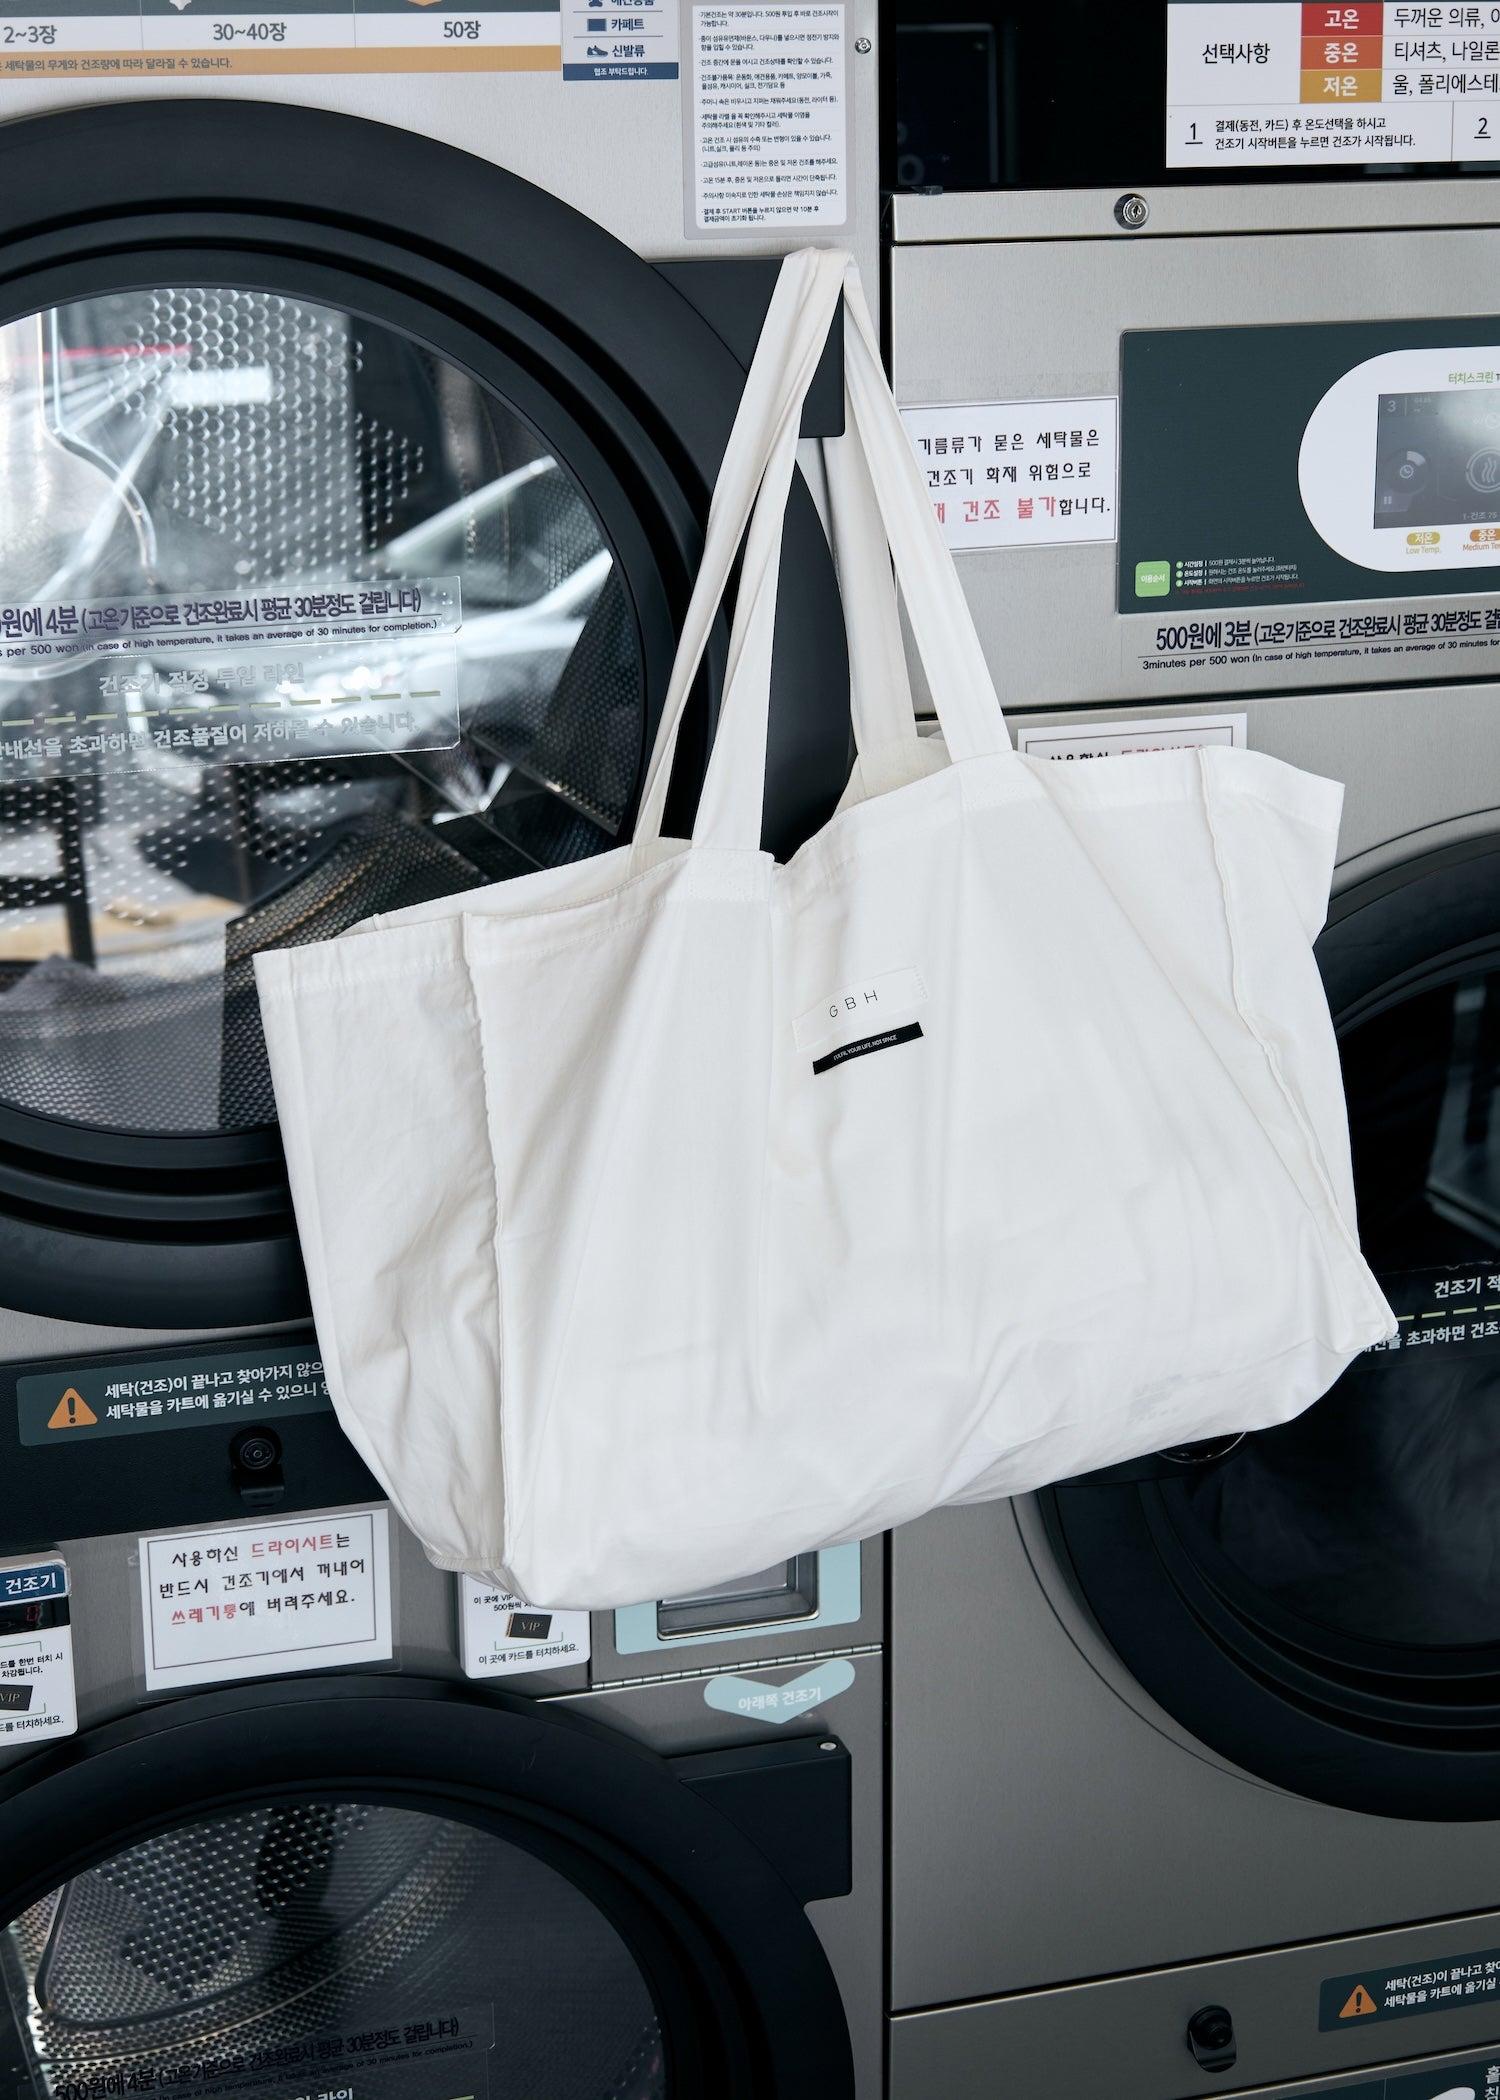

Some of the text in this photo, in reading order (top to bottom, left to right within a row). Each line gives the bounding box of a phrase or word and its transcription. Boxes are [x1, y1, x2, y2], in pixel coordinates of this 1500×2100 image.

[611, 19, 644, 31] 카페트
[1324, 8, 1360, 30] 고온
[1393, 7, 1443, 29] 두꺼운
[1449, 7, 1485, 29] 의류,
[3, 25, 57, 44] 2~3장
[213, 22, 287, 42] 30~40장
[443, 20, 481, 40] 50장
[612, 45, 645, 58] 신발류
[1202, 42, 1270, 65] 선택사항
[1323, 42, 1359, 63] 중온
[1394, 40, 1500, 62] 티셔츠, 나일론
[5, 61, 45, 72] 세탁물의
[48, 60, 77, 70] 무게와
[123, 59, 143, 69] 따라
[191, 57, 233, 68] 있습니다.
[1323, 74, 1358, 97] 저온
[1393, 74, 1414, 96] 울,
[1215, 118, 1386, 133] 결제(동전, 카드) 후 온도선택을 하시고
[1478, 118, 1488, 134] 2
[1215, 134, 1416, 150] 건조기 시작버튼을 누르면 건조가 시작됩니다.
[1448, 371, 1493, 384] 터치스크린
[1387, 400, 1396, 412] 3
[918, 429, 1099, 455] 기름류가 묻은 세탁물은
[927, 461, 1091, 487] 건조기 화재 위험으로
[963, 499, 1000, 522] 건조
[1018, 496, 1110, 519] 불가합니다.
[46, 587, 421, 634] 4분 (고온기준으로 건조완료시 평균 30분정도 걸립니다)
[7, 648, 26, 657] per
[31, 645, 52, 654] 500
[56, 645, 79, 653] won
[134, 640, 154, 649] high
[157, 636, 214, 646] temperature,
[226, 633, 249, 642] takes
[253, 632, 264, 640] an
[267, 630, 303, 640] average
[318, 628, 329, 636] 30
[332, 626, 366, 635] minutes
[369, 625, 381, 633] for
[384, 620, 437, 632] completion.)
[1156, 610, 1482, 650] 500원에 3분 (고온기준으로 건조완료시 평균 30분정도
[1143, 661, 1186, 670] 3minutes
[1189, 659, 1206, 668] per
[1210, 656, 1227, 665] 500
[1231, 656, 1249, 664] won
[1264, 653, 1283, 661] case
[1285, 652, 1293, 660] of
[1296, 651, 1311, 660] high
[1315, 650, 1361, 658] temperature,
[1371, 646, 1391, 654] takes
[1406, 644, 1435, 653] average
[1448, 641, 1457, 649] 30
[1459, 640, 1488, 648] minutes
[99, 670, 209, 697] 건조기 적정
[69, 723, 247, 754] 초과하면 건조품질이
[829, 990, 878, 1017] GBH
[1434, 1276, 1482, 1298] 건조기
[1406, 1324, 1466, 1345] 초과하면
[105, 1364, 293, 1399] 세탁(건조)이 끝나고 찾아가지
[106, 1400, 163, 1419] 세탁물을
[167, 1393, 209, 1413] 카트에
[212, 1389, 254, 1408] 옮기실
[258, 1388, 273, 1401] 수
[276, 1383, 317, 1401] 있으니
[172, 1533, 350, 1567] 사용하신 드라이시트는
[5, 1572, 56, 1595] 건조기
[160, 1558, 365, 1599] 반드시 건조기에서 꺼내어
[172, 1589, 355, 1625] 쓰레기통에 버려주세요.
[522, 1622, 540, 1631] VIP
[19, 1655, 53, 1667] 한번 터치
[479, 1643, 579, 1664] 이 곳에 카드를 터치하세요.
[1, 1665, 43, 1678] 차감됩니다.
[782, 1687, 820, 1705] 건조기
[17, 1714, 64, 1730] 터치하세요.
[1385, 1965, 1482, 1991] 세탁(건조)이 끝나고
[1384, 1977, 1497, 2008] 세탁물을 카트에 옮기실
[404, 2017, 459, 2044] 걸립니다)
